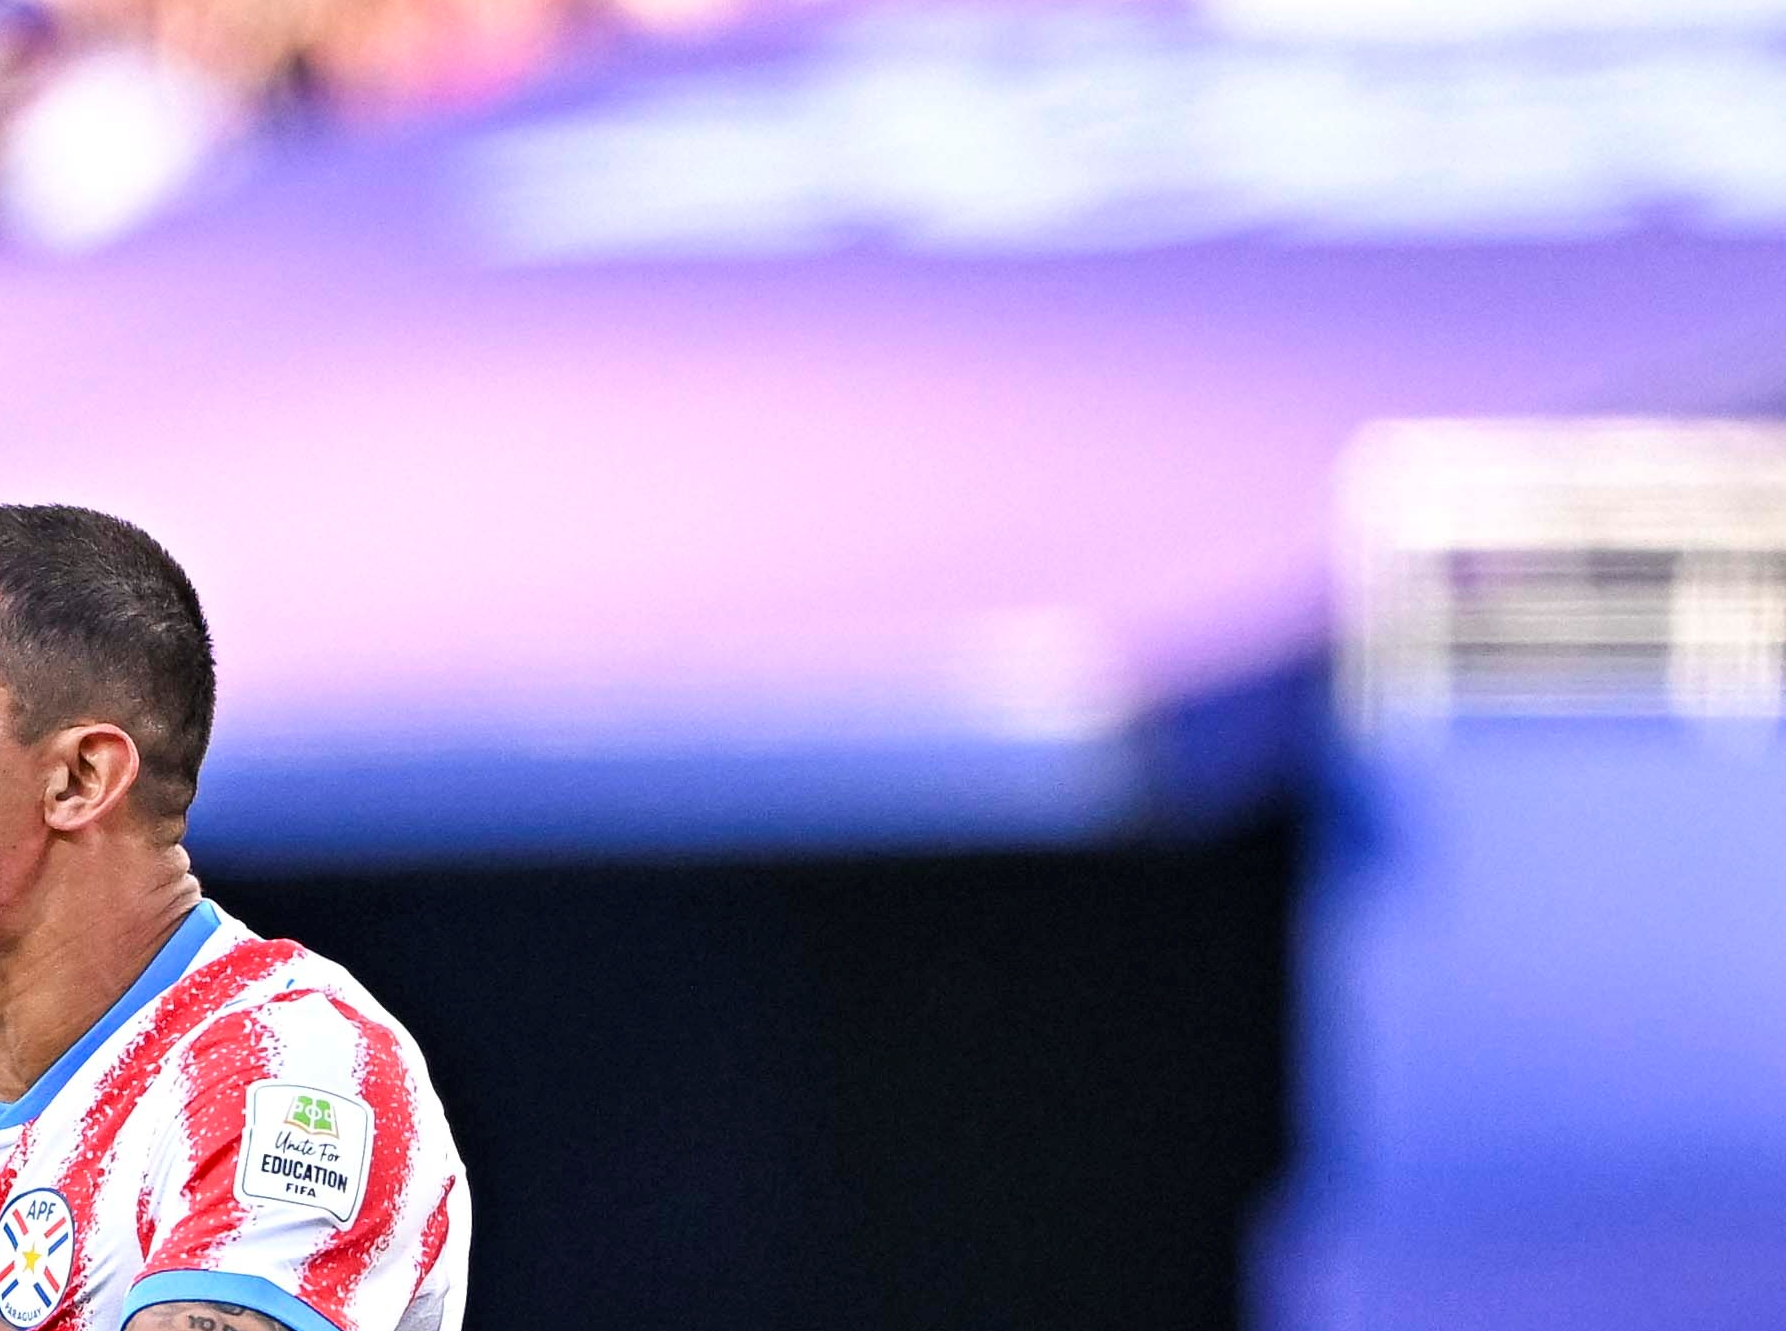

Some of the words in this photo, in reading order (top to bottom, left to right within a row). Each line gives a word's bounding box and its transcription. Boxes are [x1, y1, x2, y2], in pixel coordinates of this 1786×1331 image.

[274, 1130, 317, 1156] Unite
[318, 1142, 341, 1162] For
[260, 1153, 349, 1194] EDUCATION
[285, 1182, 317, 1198] FIFA
[25, 1199, 57, 1222] APF
[4, 1301, 42, 1322] PARAGUAY
